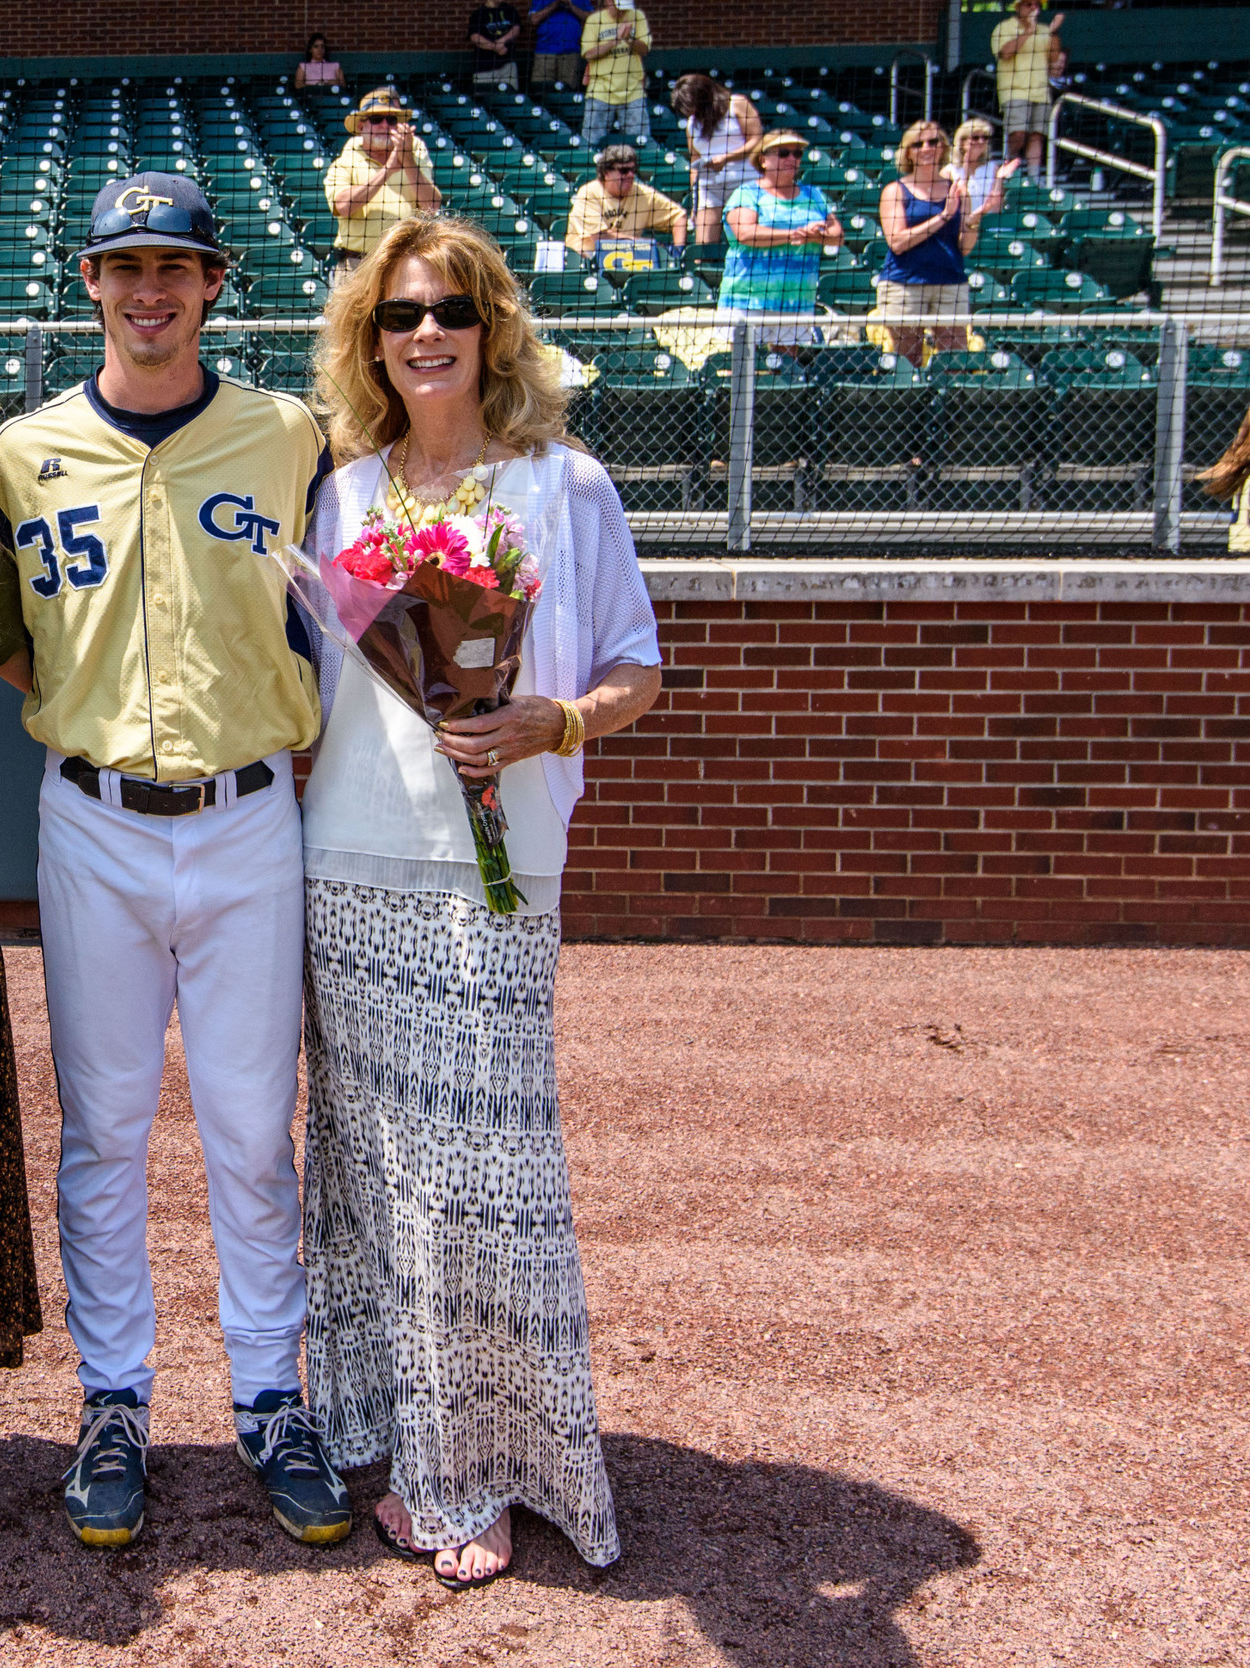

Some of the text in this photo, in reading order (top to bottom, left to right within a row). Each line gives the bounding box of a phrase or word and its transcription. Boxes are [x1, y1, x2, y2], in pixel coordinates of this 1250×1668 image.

[115, 185, 173, 215] GT
[38, 470, 69, 482] RUSSELL
[197, 491, 281, 557] GT
[15, 503, 110, 600] 35
